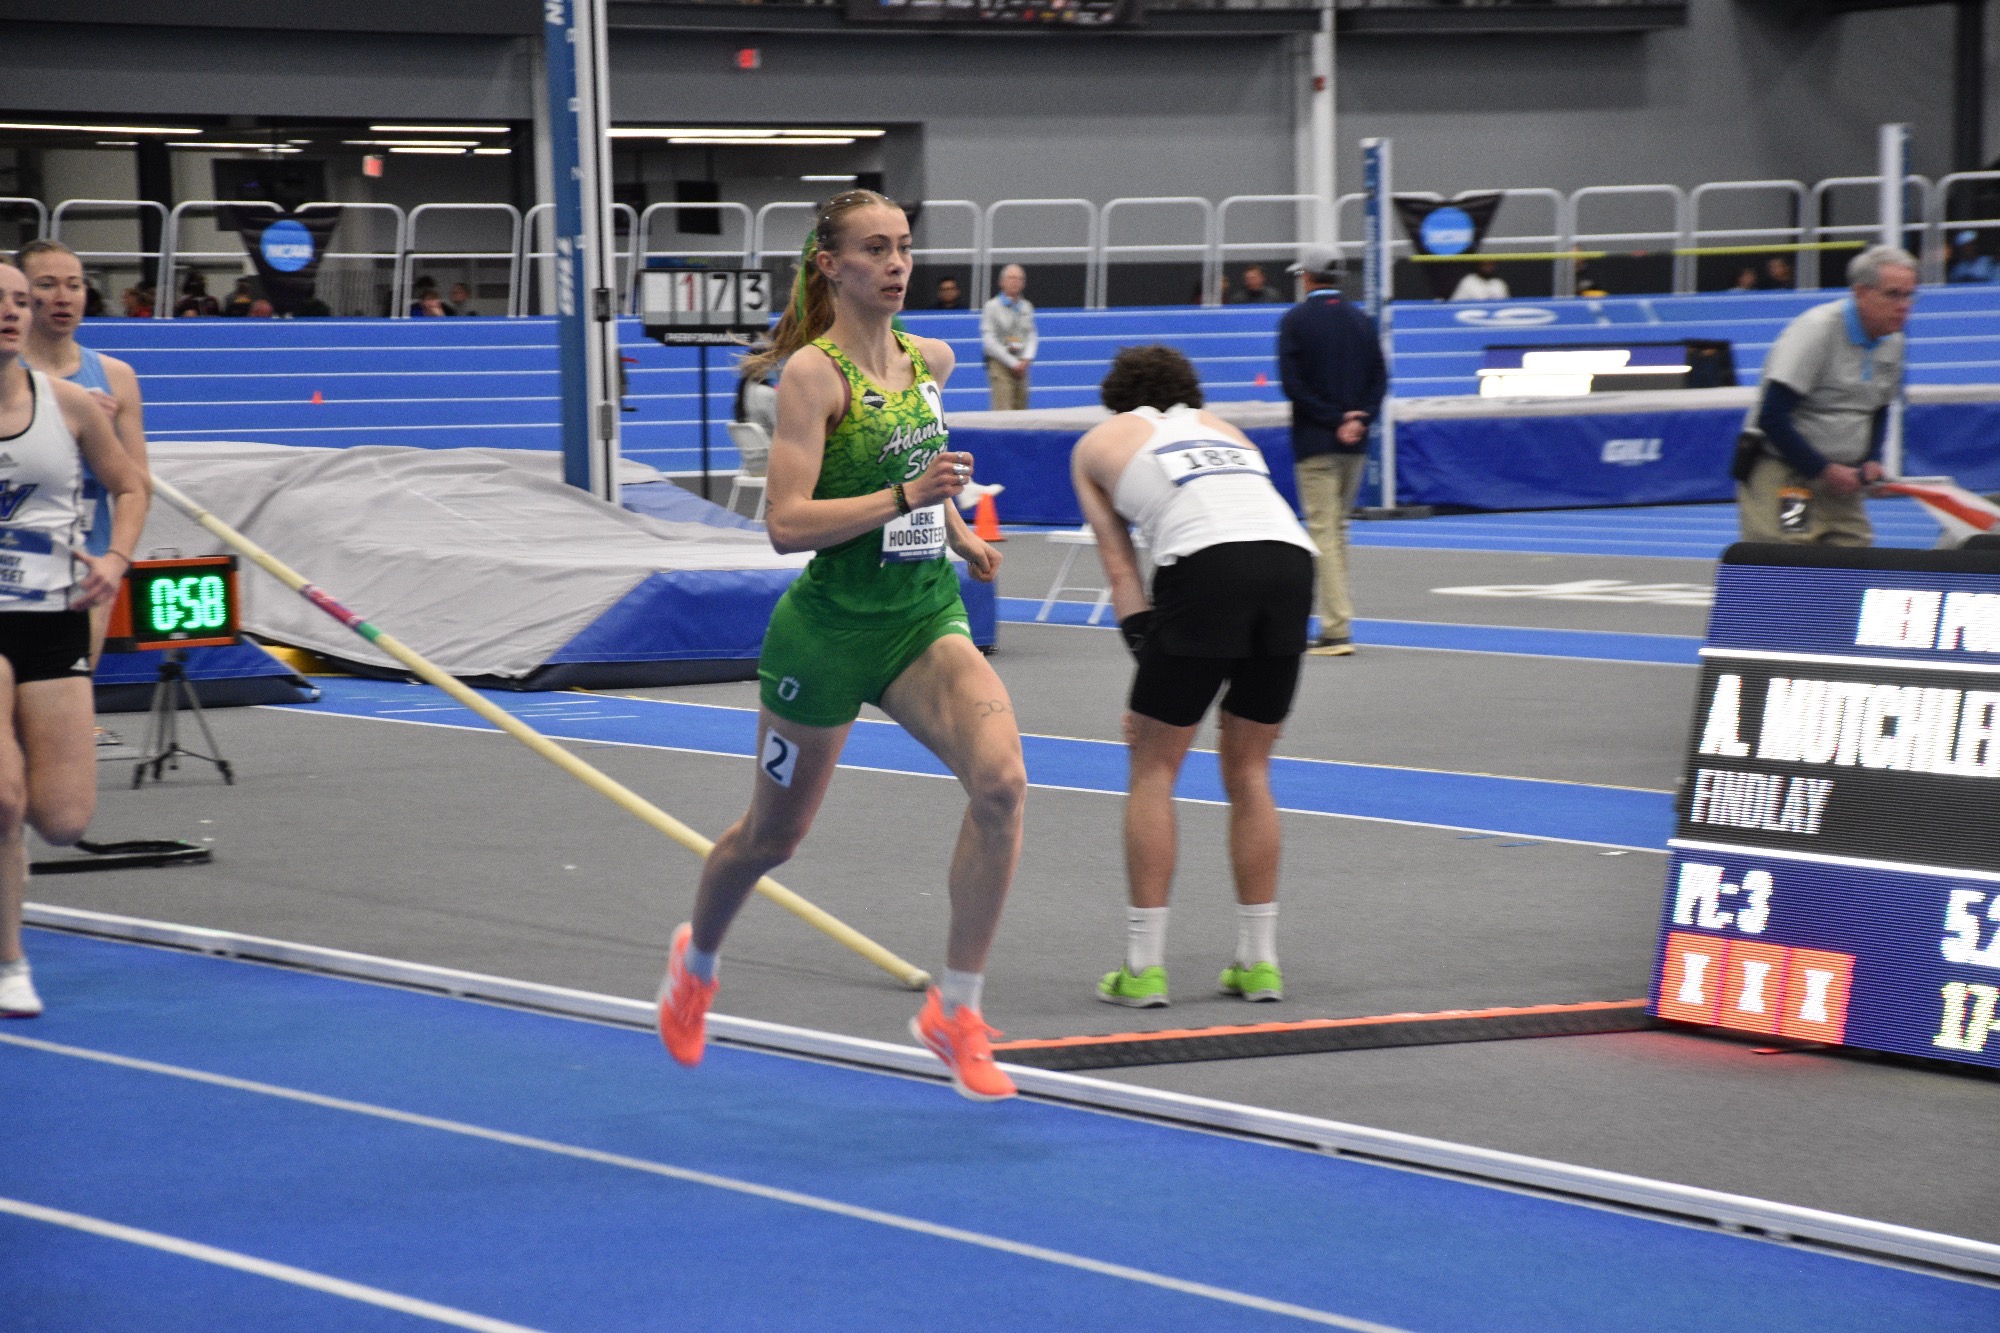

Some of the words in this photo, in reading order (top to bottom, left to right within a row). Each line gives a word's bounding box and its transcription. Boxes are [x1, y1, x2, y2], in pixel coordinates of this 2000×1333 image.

[878, 422, 937, 464] Adam
[910, 511, 935, 526] LIEKE
[150, 575, 227, 631] 0:58
[1755, 676, 2000, 778] MUTCHLE
[765, 736, 789, 781] 2
[1690, 768, 1836, 834] FINDLAY
